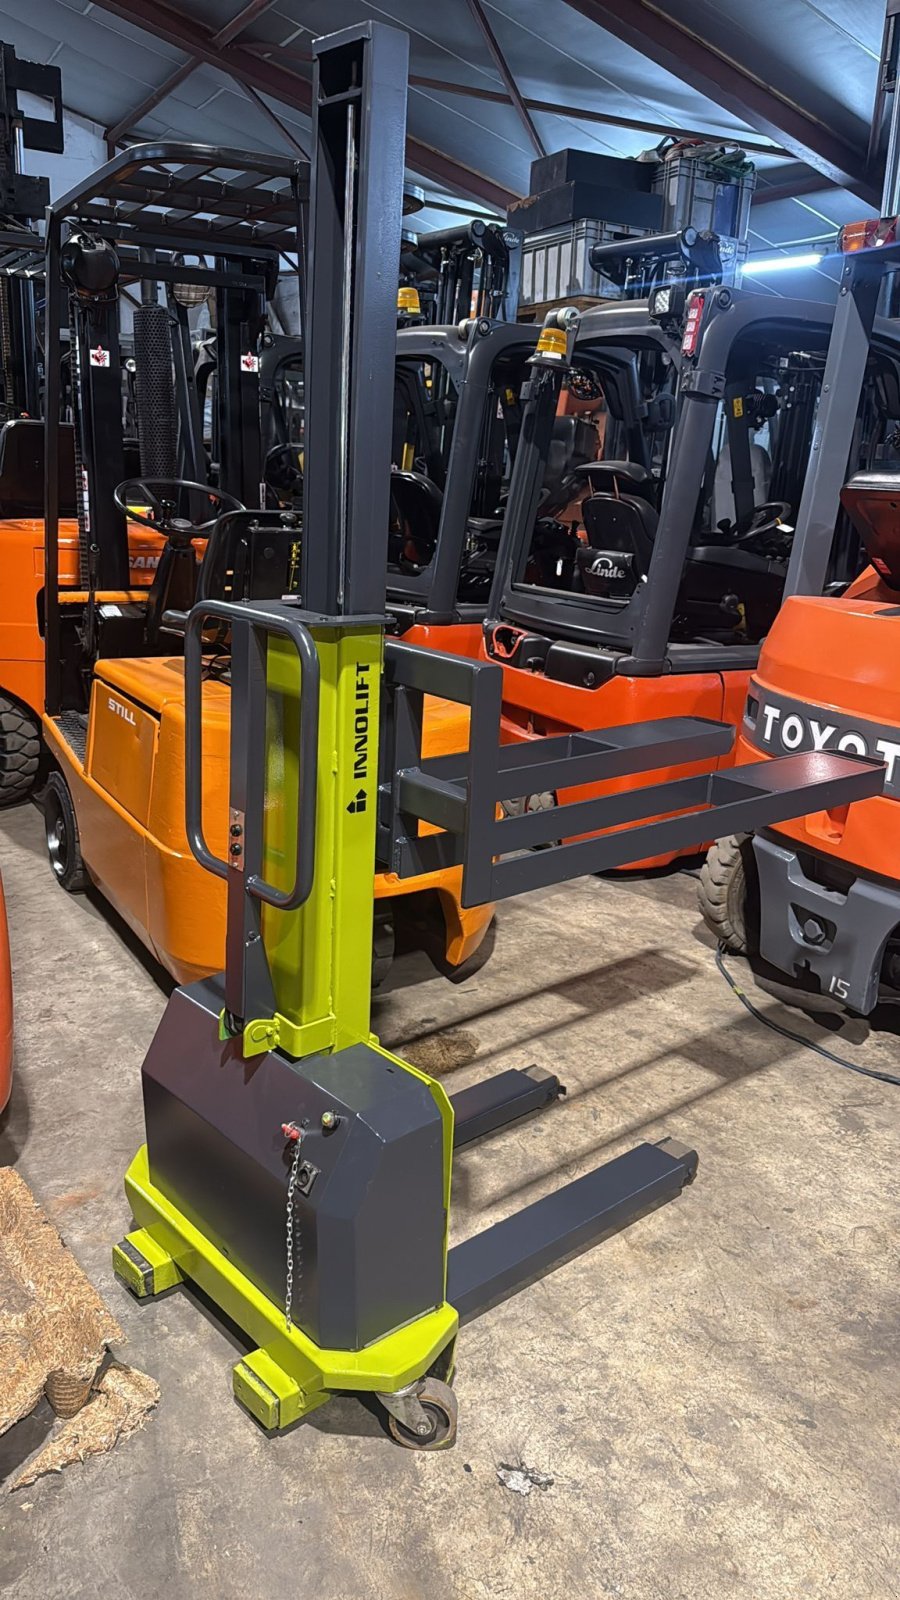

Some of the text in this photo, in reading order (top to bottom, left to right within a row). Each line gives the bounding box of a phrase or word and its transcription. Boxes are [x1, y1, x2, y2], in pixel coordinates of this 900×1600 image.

[585, 557, 626, 578] Linde
[108, 697, 137, 726] STILL
[354, 662, 370, 779] INNOLIFT
[829, 975, 851, 999] 15
